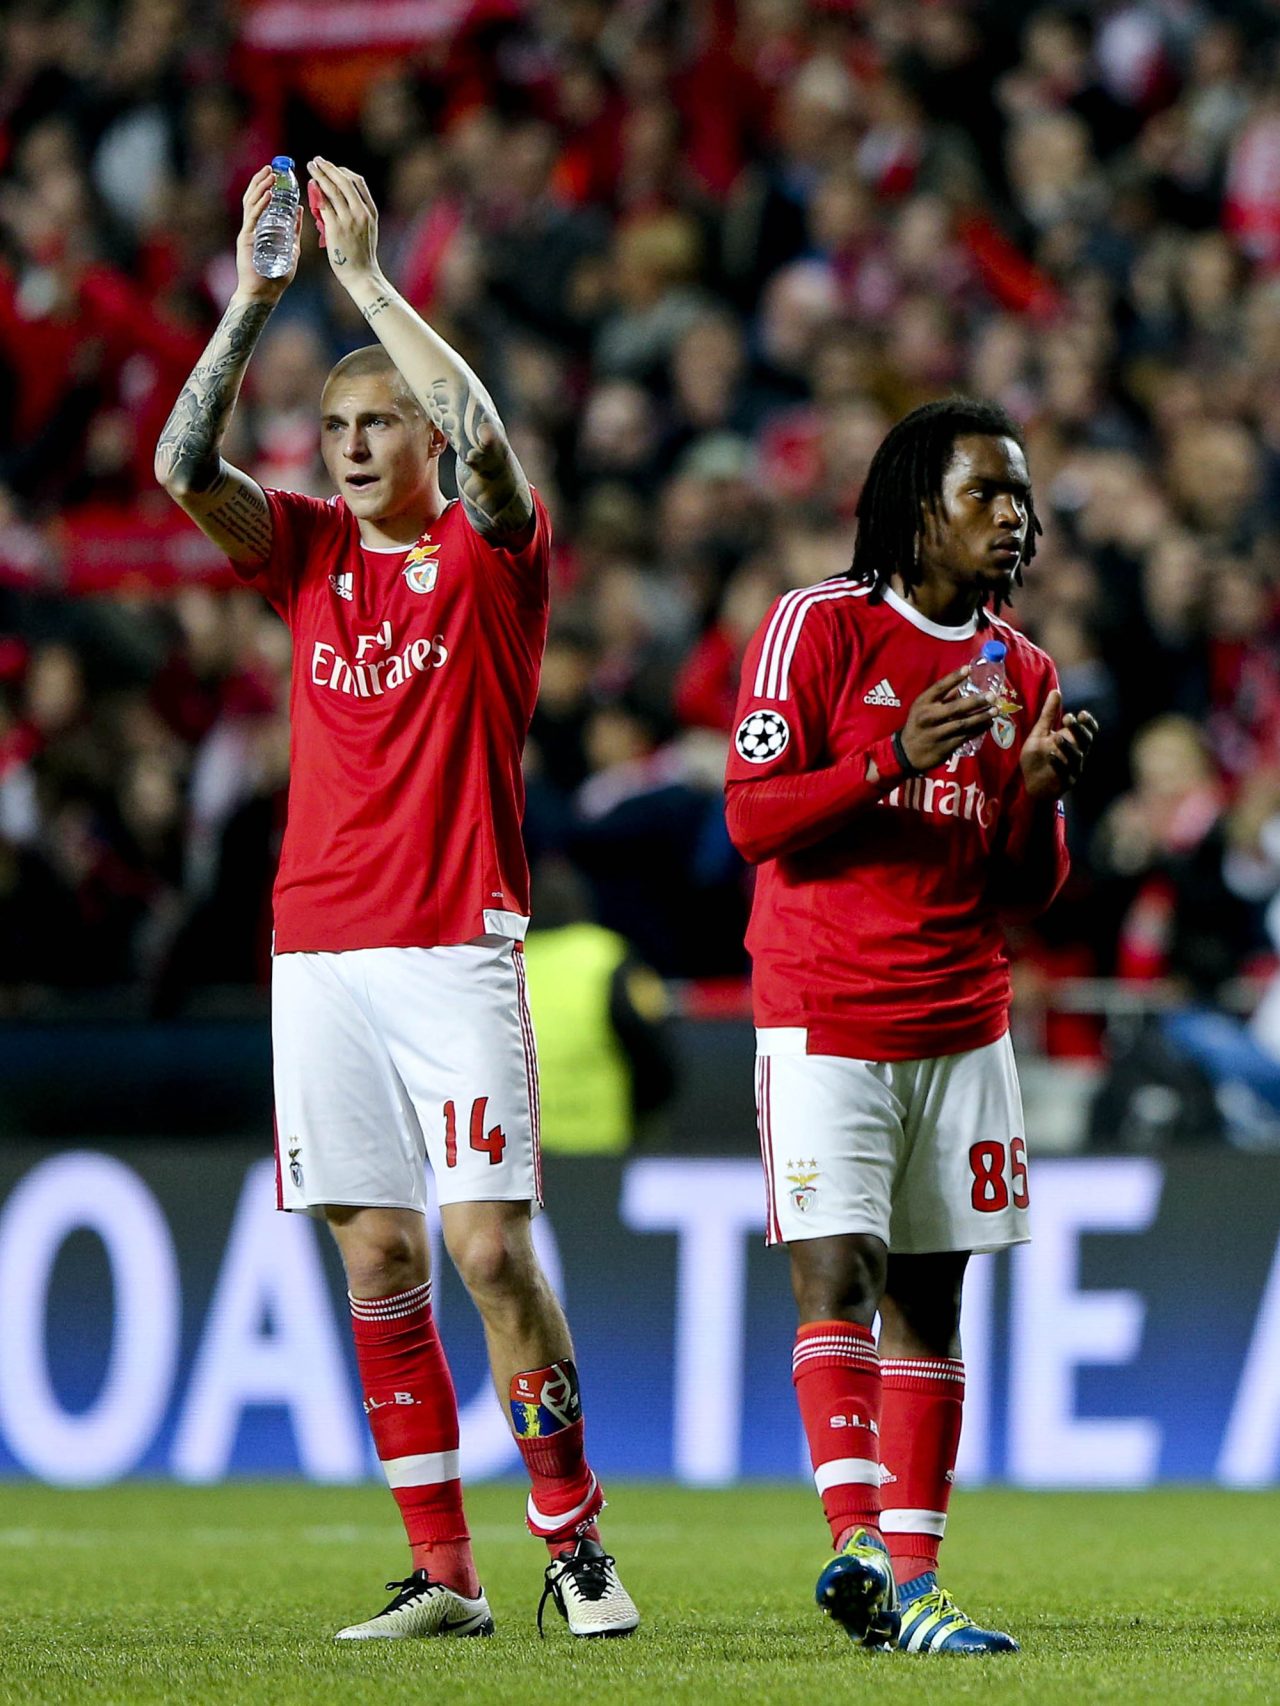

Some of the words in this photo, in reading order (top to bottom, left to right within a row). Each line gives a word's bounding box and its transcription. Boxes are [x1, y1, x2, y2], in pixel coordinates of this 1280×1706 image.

[355, 620, 393, 659] Fy
[311, 634, 449, 697] Emirates
[863, 693, 901, 708] adidas
[443, 1096, 506, 1168] 14
